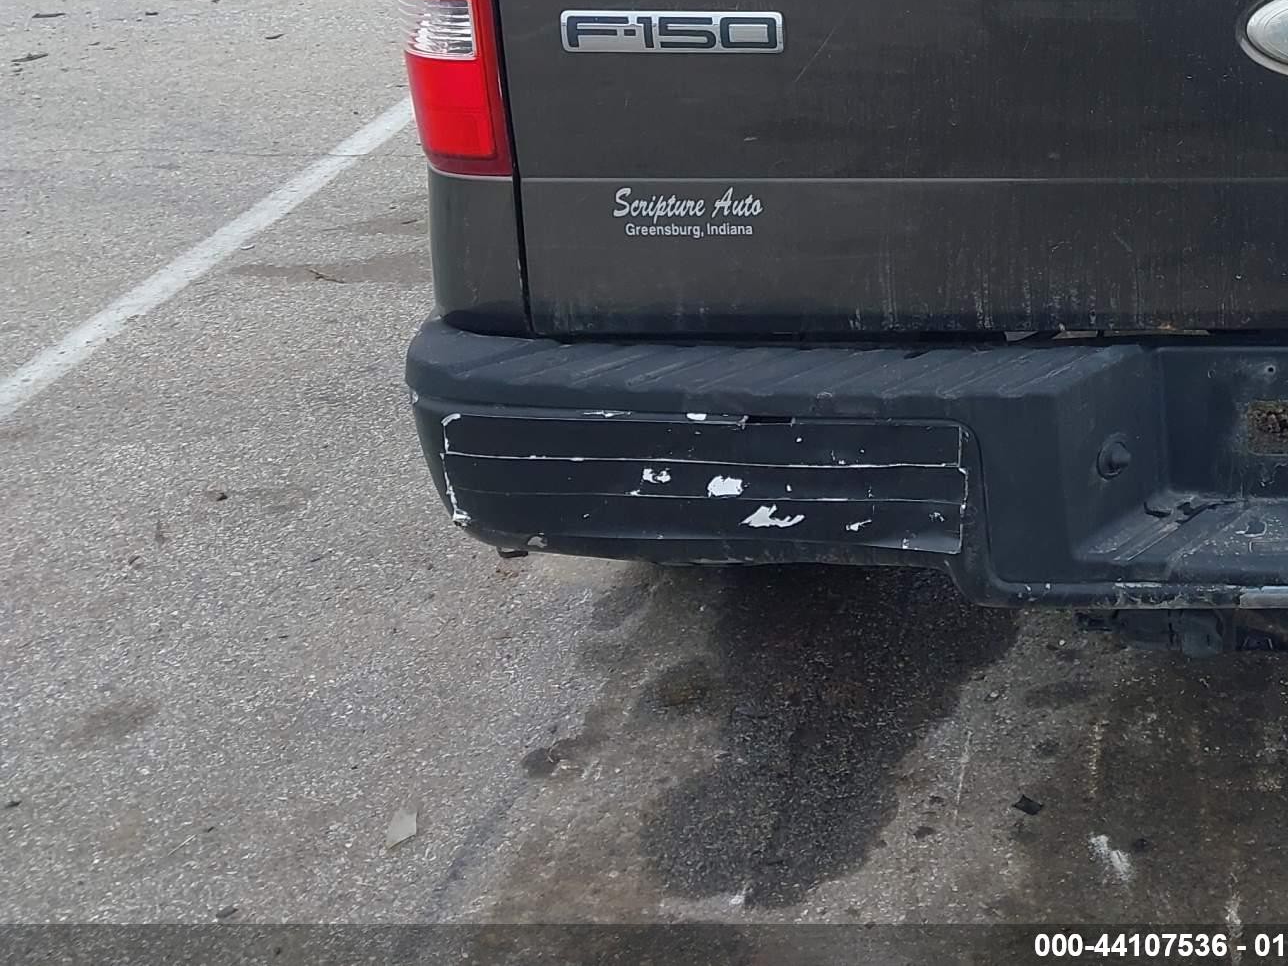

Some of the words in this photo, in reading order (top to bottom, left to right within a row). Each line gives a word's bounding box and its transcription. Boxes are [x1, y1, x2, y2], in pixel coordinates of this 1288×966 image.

[564, 14, 780, 50] F-150
[613, 187, 706, 224] Scripture
[711, 187, 763, 218] Auto
[625, 223, 704, 238] Greensburg,
[707, 223, 753, 235] Indiana
